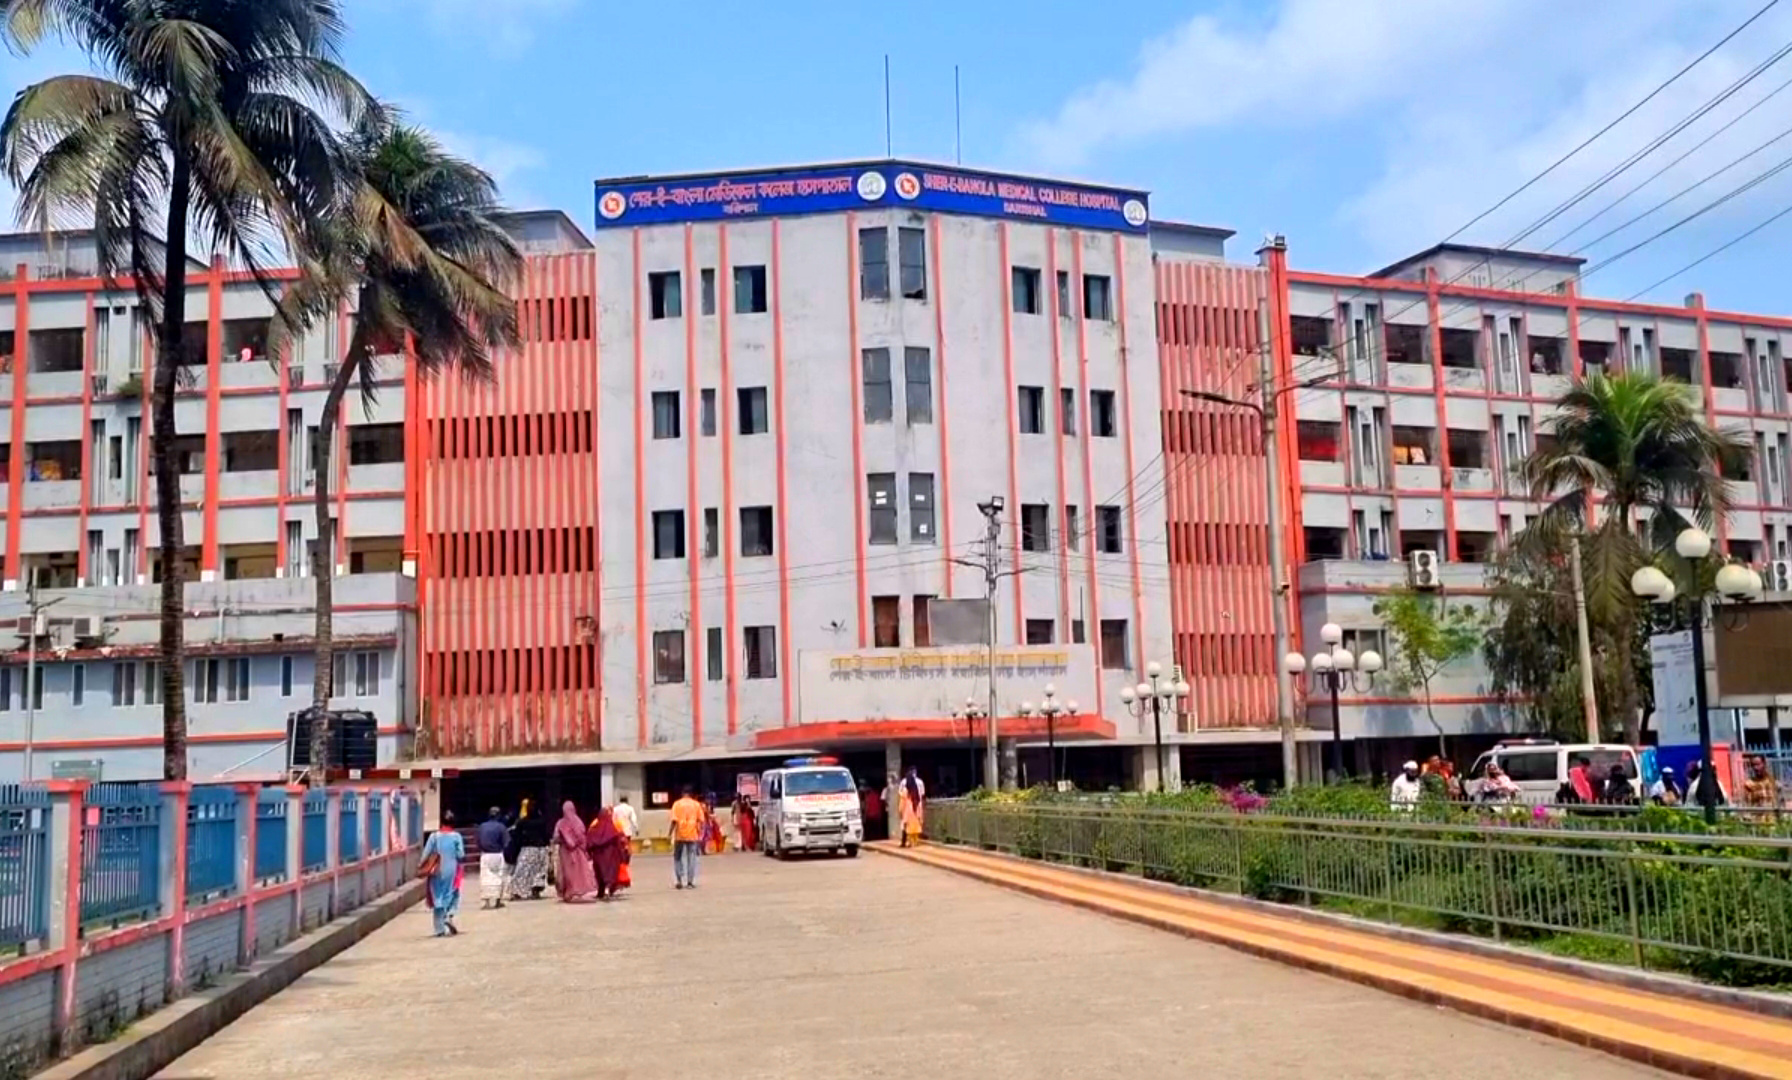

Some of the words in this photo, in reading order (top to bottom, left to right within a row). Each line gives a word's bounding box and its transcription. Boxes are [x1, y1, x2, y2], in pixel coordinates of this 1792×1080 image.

[997, 182, 1037, 201] MEDICAL
[1038, 187, 1079, 206] COLLEGE
[1080, 192, 1121, 211] HOSPITAL
